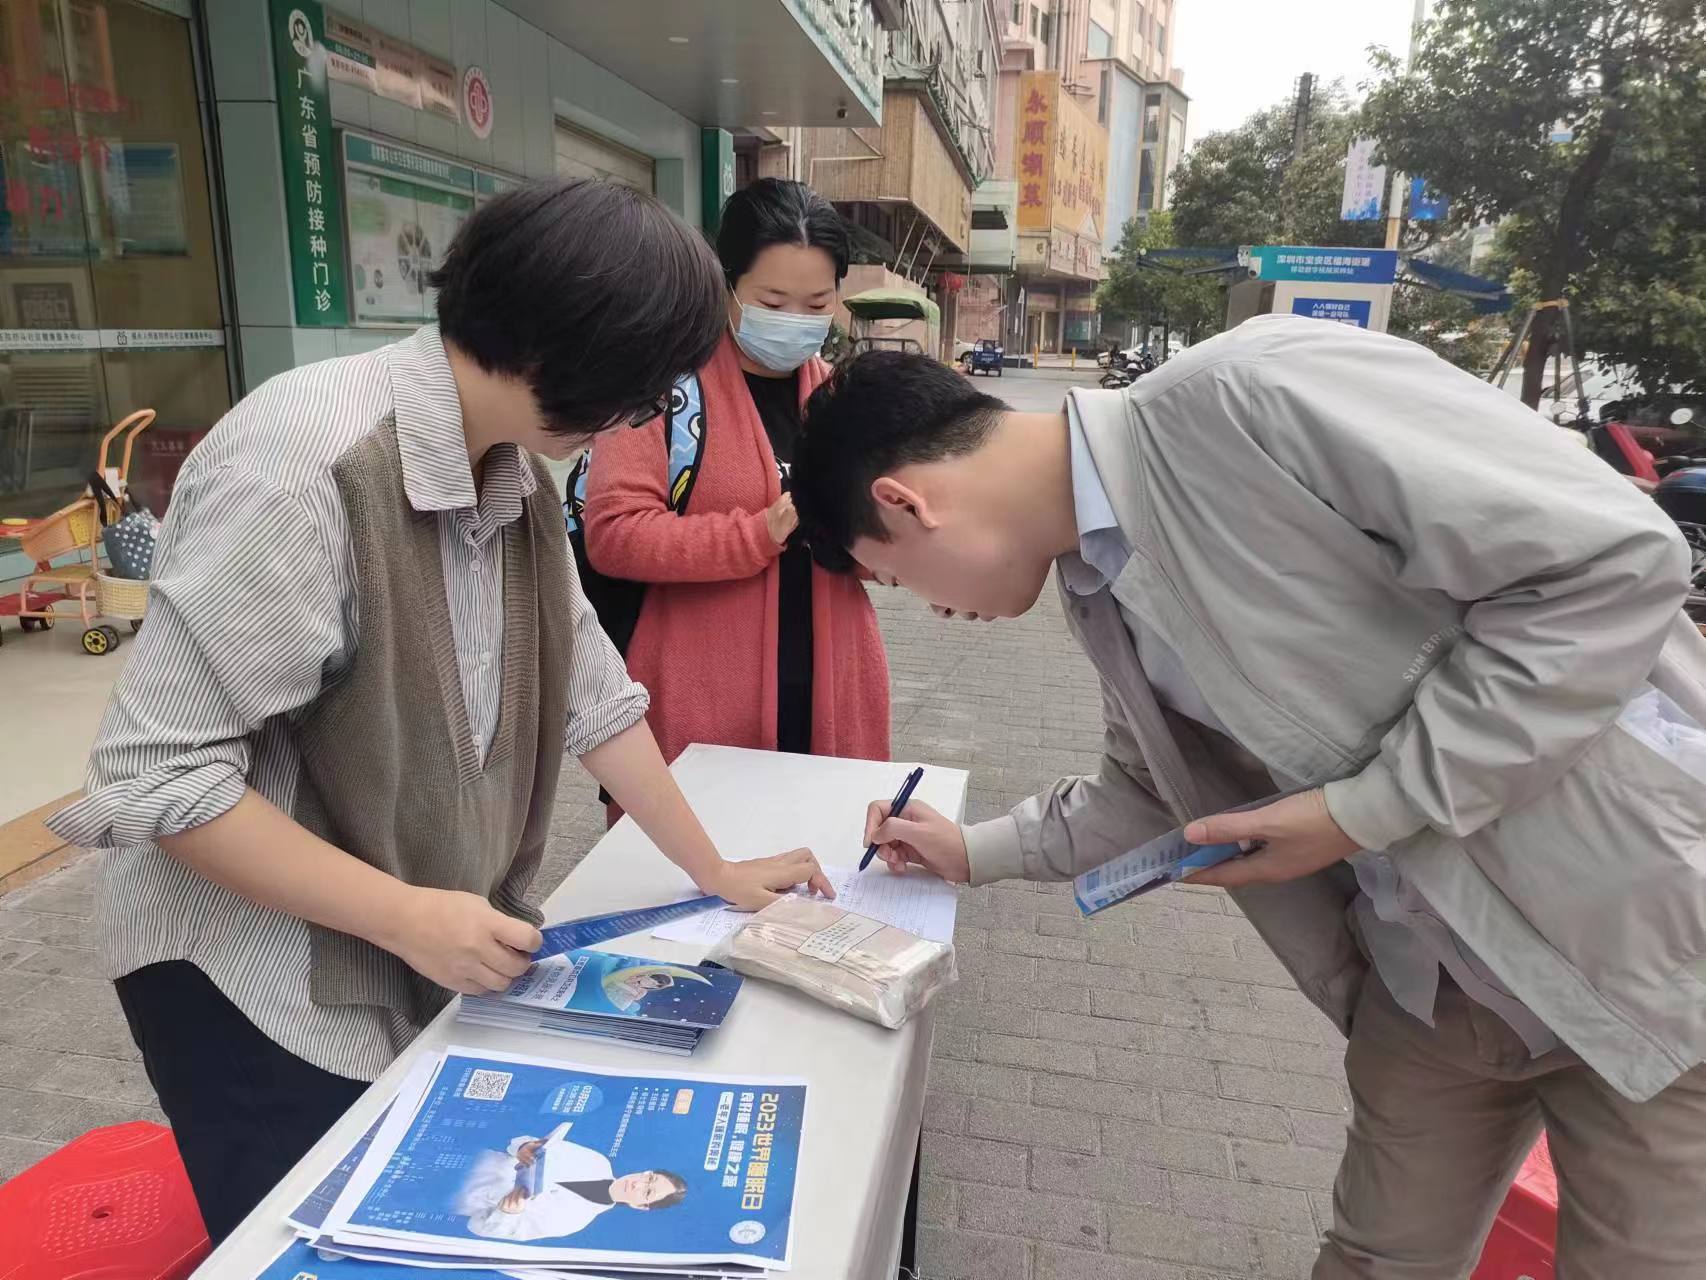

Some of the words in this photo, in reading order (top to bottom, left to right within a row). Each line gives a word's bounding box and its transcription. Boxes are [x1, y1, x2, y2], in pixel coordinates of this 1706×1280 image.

[297, 67, 332, 313] 广东省预防接种门诊
[741, 1092, 780, 1210] 2023世界睡眠日
